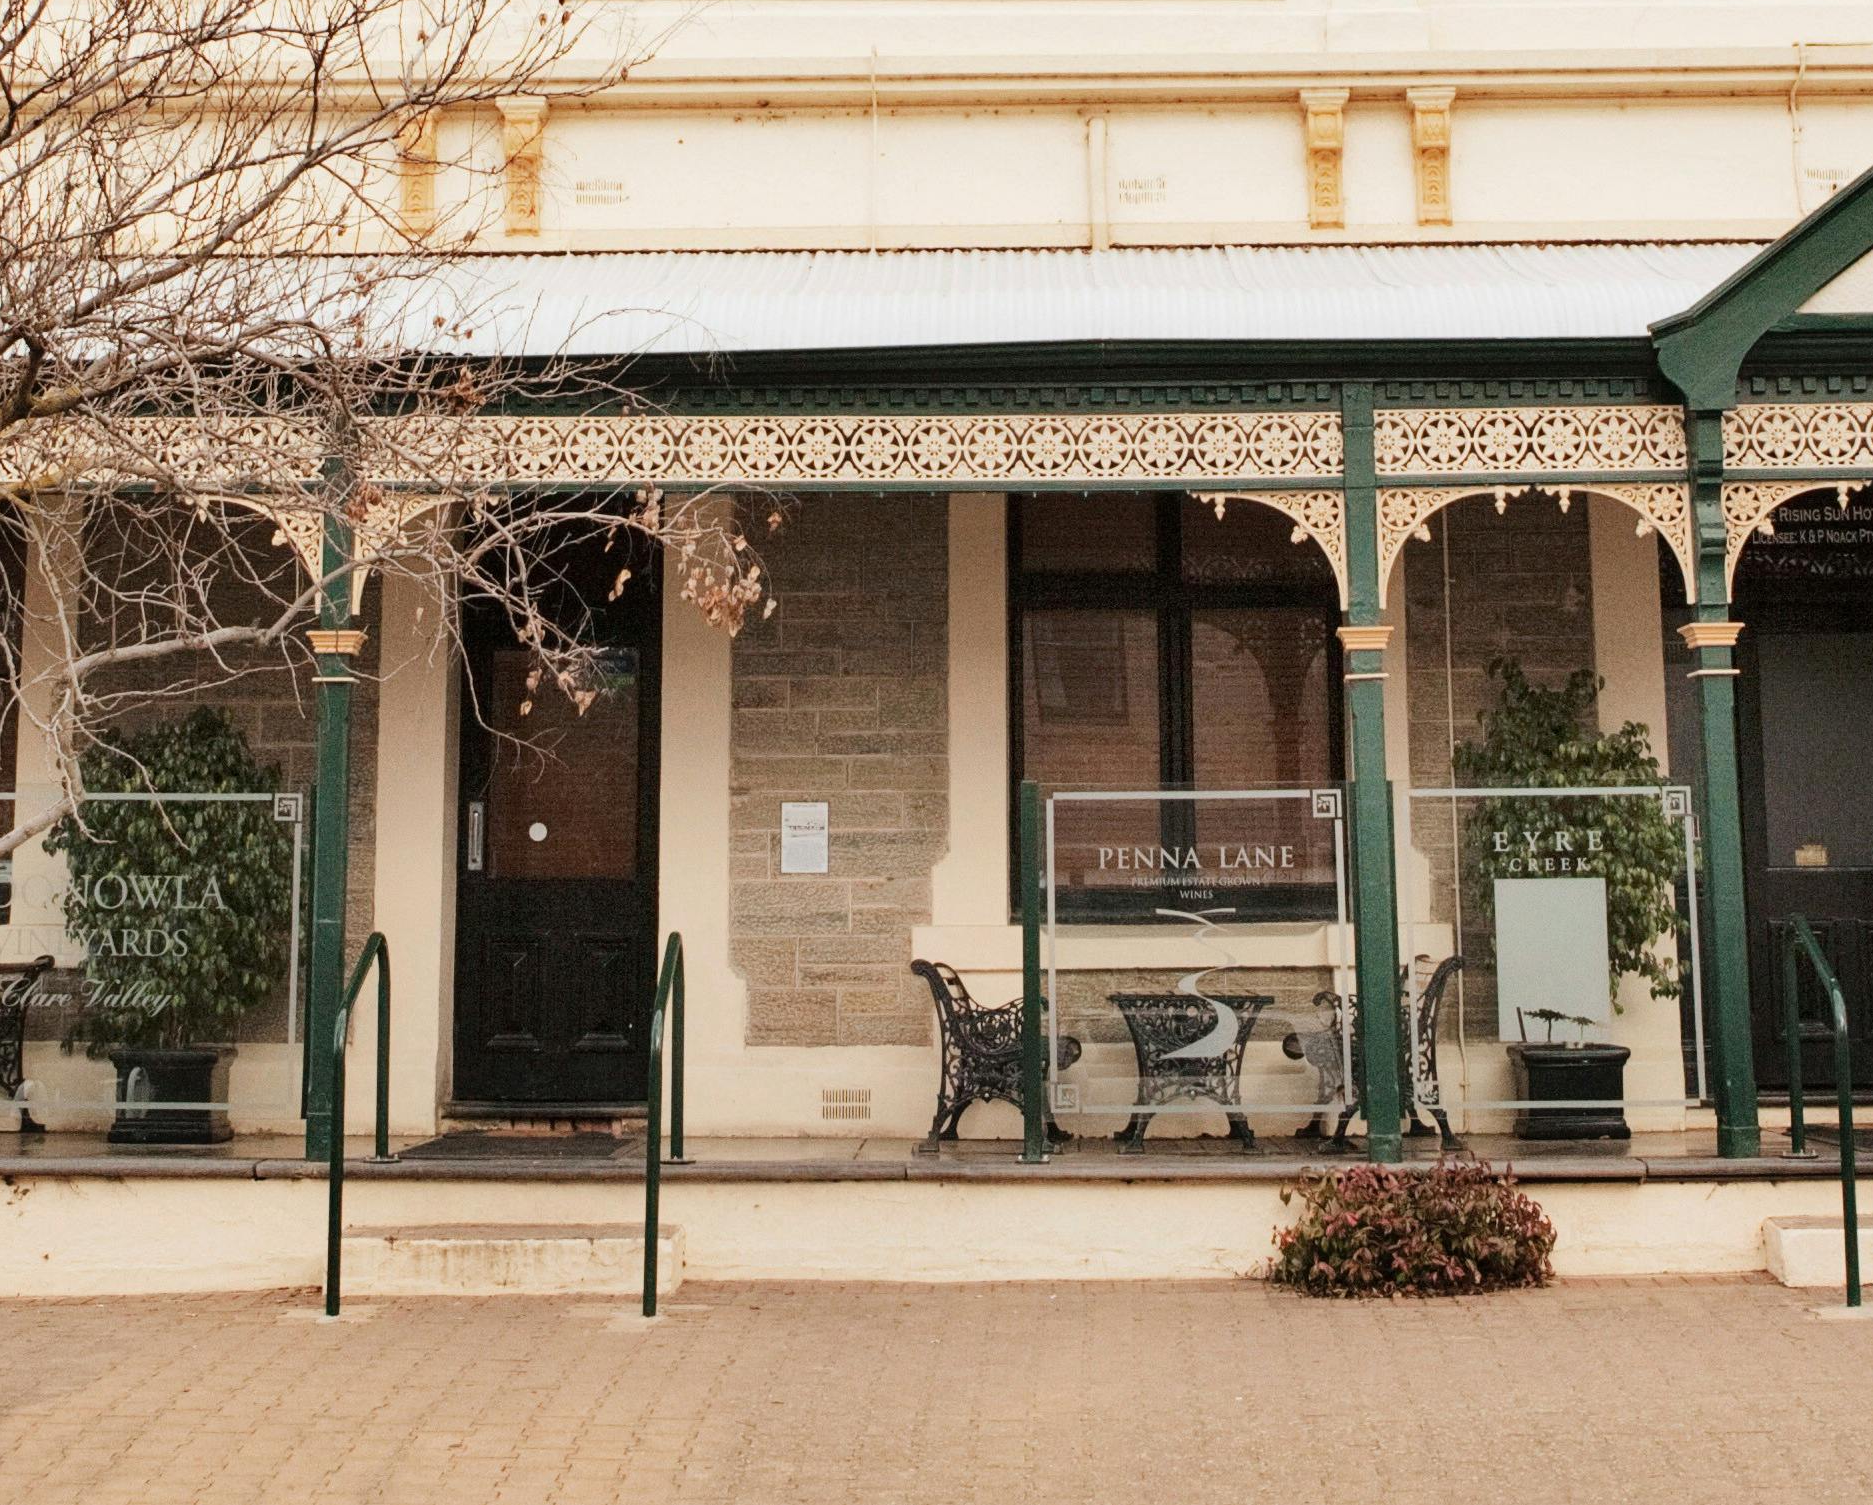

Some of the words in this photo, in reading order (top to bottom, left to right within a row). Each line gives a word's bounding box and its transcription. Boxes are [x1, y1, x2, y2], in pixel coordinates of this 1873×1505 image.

[1779, 506, 1821, 521] RISING
[1824, 506, 1850, 521] SUN
[1493, 831, 1604, 852] EYRE
[1098, 846, 1203, 870] PENNA
[1218, 845, 1296, 869] LANE
[1508, 857, 1592, 872] CREEK
[1179, 889, 1214, 900] WINES
[80, 978, 174, 1017] Valley
